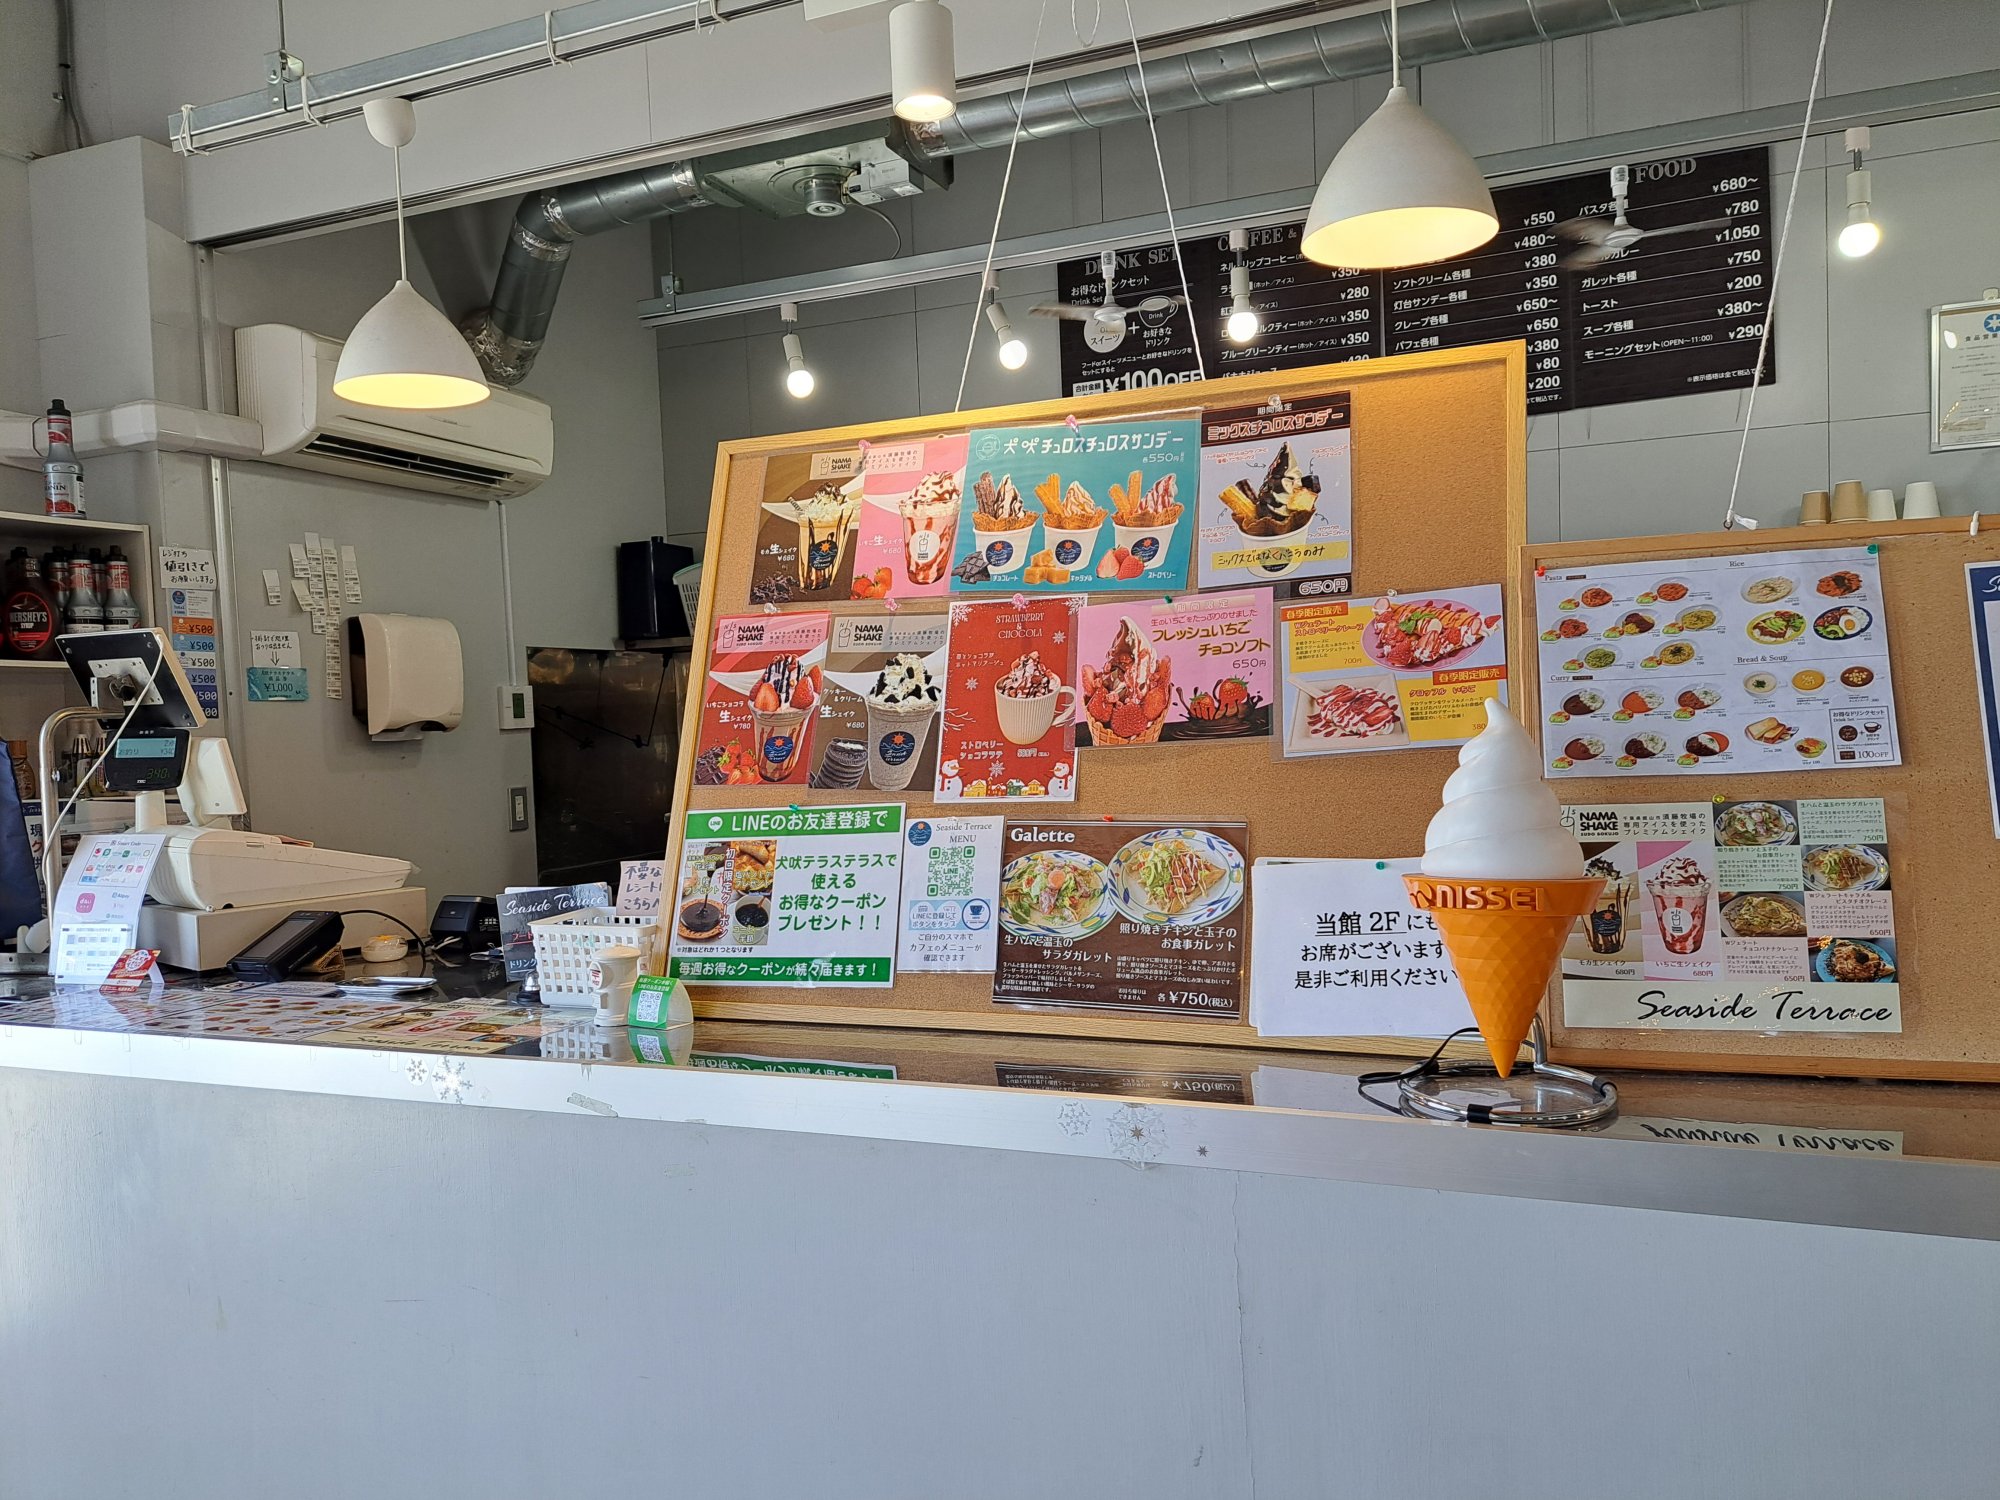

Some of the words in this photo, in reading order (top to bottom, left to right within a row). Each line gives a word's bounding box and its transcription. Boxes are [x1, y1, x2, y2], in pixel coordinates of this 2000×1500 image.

[1635, 158, 1697, 184] FOOD
[1725, 200, 1759, 216] ¥780
[1524, 211, 1555, 227] ¥550
[1217, 227, 1284, 251] CFEE
[1288, 228, 1296, 239] &
[1716, 225, 1760, 242] ¥1,050
[1085, 252, 1142, 276] DNK
[1148, 245, 1181, 265] SET
[1525, 253, 1557, 269] ¥380
[1727, 249, 1761, 265] ¥750
[1071, 275, 1150, 297] お得なドンクセット
[1393, 269, 1472, 290] ソフトクリーム各種
[1525, 275, 1557, 290] ¥350
[1581, 270, 1638, 288] ガレット各種
[1726, 274, 1762, 290] ¥200
[1341, 286, 1370, 300] ¥280
[1394, 290, 1468, 311] 灯台サンデー各種
[1582, 299, 1619, 312] トースト
[1341, 309, 1370, 322] ¥350
[1395, 314, 1449, 331] クレープ各種
[1527, 317, 1558, 332] ¥650
[1583, 320, 1634, 336] スープ各種
[1728, 324, 1764, 339] ¥290
[1143, 326, 1172, 339] お好きな
[1341, 331, 1370, 345] ¥350
[1090, 334, 1121, 346] スイーツ
[1145, 337, 1171, 349] ドリンク
[1395, 336, 1439, 351] パフェ各種
[1527, 338, 1559, 353] ¥380
[1536, 357, 1560, 370] ¥80
[1081, 366, 1116, 376] セットにすると
[1529, 376, 1560, 390] ¥200
[1207, 409, 1344, 441] ミックスチュロスサンデー
[831, 457, 852, 465] NAMA
[164, 560, 210, 573] 値引きで
[1729, 560, 1745, 568] Rice
[1299, 578, 1349, 596] 650円
[9, 611, 48, 623] HERSHEY'S
[996, 613, 1045, 624] STRAWBERRY
[189, 624, 213, 634] ¥500
[738, 624, 765, 634] NAMA
[854, 624, 884, 633] NAMA
[998, 628, 1043, 639] CHOCOLA
[1152, 619, 1252, 643] フレッシュいちご
[737, 632, 764, 642] SHAKE
[853, 632, 883, 642] SHAKE
[190, 641, 214, 650] ¥500
[1198, 639, 1271, 657] チョコソフト
[191, 657, 215, 667] ¥500
[1232, 658, 1266, 669] 650円
[1769, 654, 1788, 662] Soup
[191, 674, 216, 683] ¥500
[1550, 674, 1570, 682] Curry
[264, 683, 294, 693] ¥1,000
[706, 701, 744, 709] いちごショコラ
[820, 704, 856, 718] 生シェイク
[719, 710, 752, 723] 生シェイク
[960, 740, 1004, 750] ストロベリー
[731, 811, 889, 832] LINEのお友達登録で
[1579, 811, 1618, 821] NAMA
[935, 823, 963, 832] Seaside
[964, 822, 993, 831] Terrace
[1580, 821, 1619, 831] SHAKE
[1624, 828, 1706, 836] プレミアムシェイク
[949, 835, 977, 844] MENU
[1010, 827, 1076, 843] Galette
[775, 854, 897, 870] 犬吠テラステラスで
[943, 867, 959, 875] LINE
[626, 880, 662, 894] レシート
[811, 873, 857, 889] 使える
[502, 899, 551, 916] Seaside
[553, 893, 604, 911] Terrace
[779, 895, 887, 911] お得なクーポン
[1436, 884, 1545, 912] NISSEI
[778, 915, 881, 931] プレゼント！！
[1119, 922, 1237, 938] 照り焼きチキンと玉子の
[1316, 911, 1362, 936] 当館
[1369, 911, 1401, 933] 2F
[918, 933, 974, 941] ご自分のスマホで
[1004, 934, 1074, 948] 生ハムと温玉の
[909, 943, 982, 952] カフェのメニューが
[1161, 938, 1236, 953] お食事ガレット
[1301, 940, 1444, 962] お席がございます
[923, 954, 966, 962] 確認できます
[1042, 949, 1112, 963] サラダガレット
[509, 958, 538, 969] ドリンク
[679, 962, 877, 977] 毎週お得なクーポンが続々届きます！
[1655, 960, 1712, 968] いちご生シェイク
[1294, 968, 1458, 990] 是非ご利用ください
[1692, 969, 1714, 977] 680円
[1157, 993, 1166, 1002] 各
[1169, 990, 1233, 1008] ¥750(税込)
[1637, 990, 1757, 1020] Seaside
[1771, 990, 1893, 1021] Terrace
